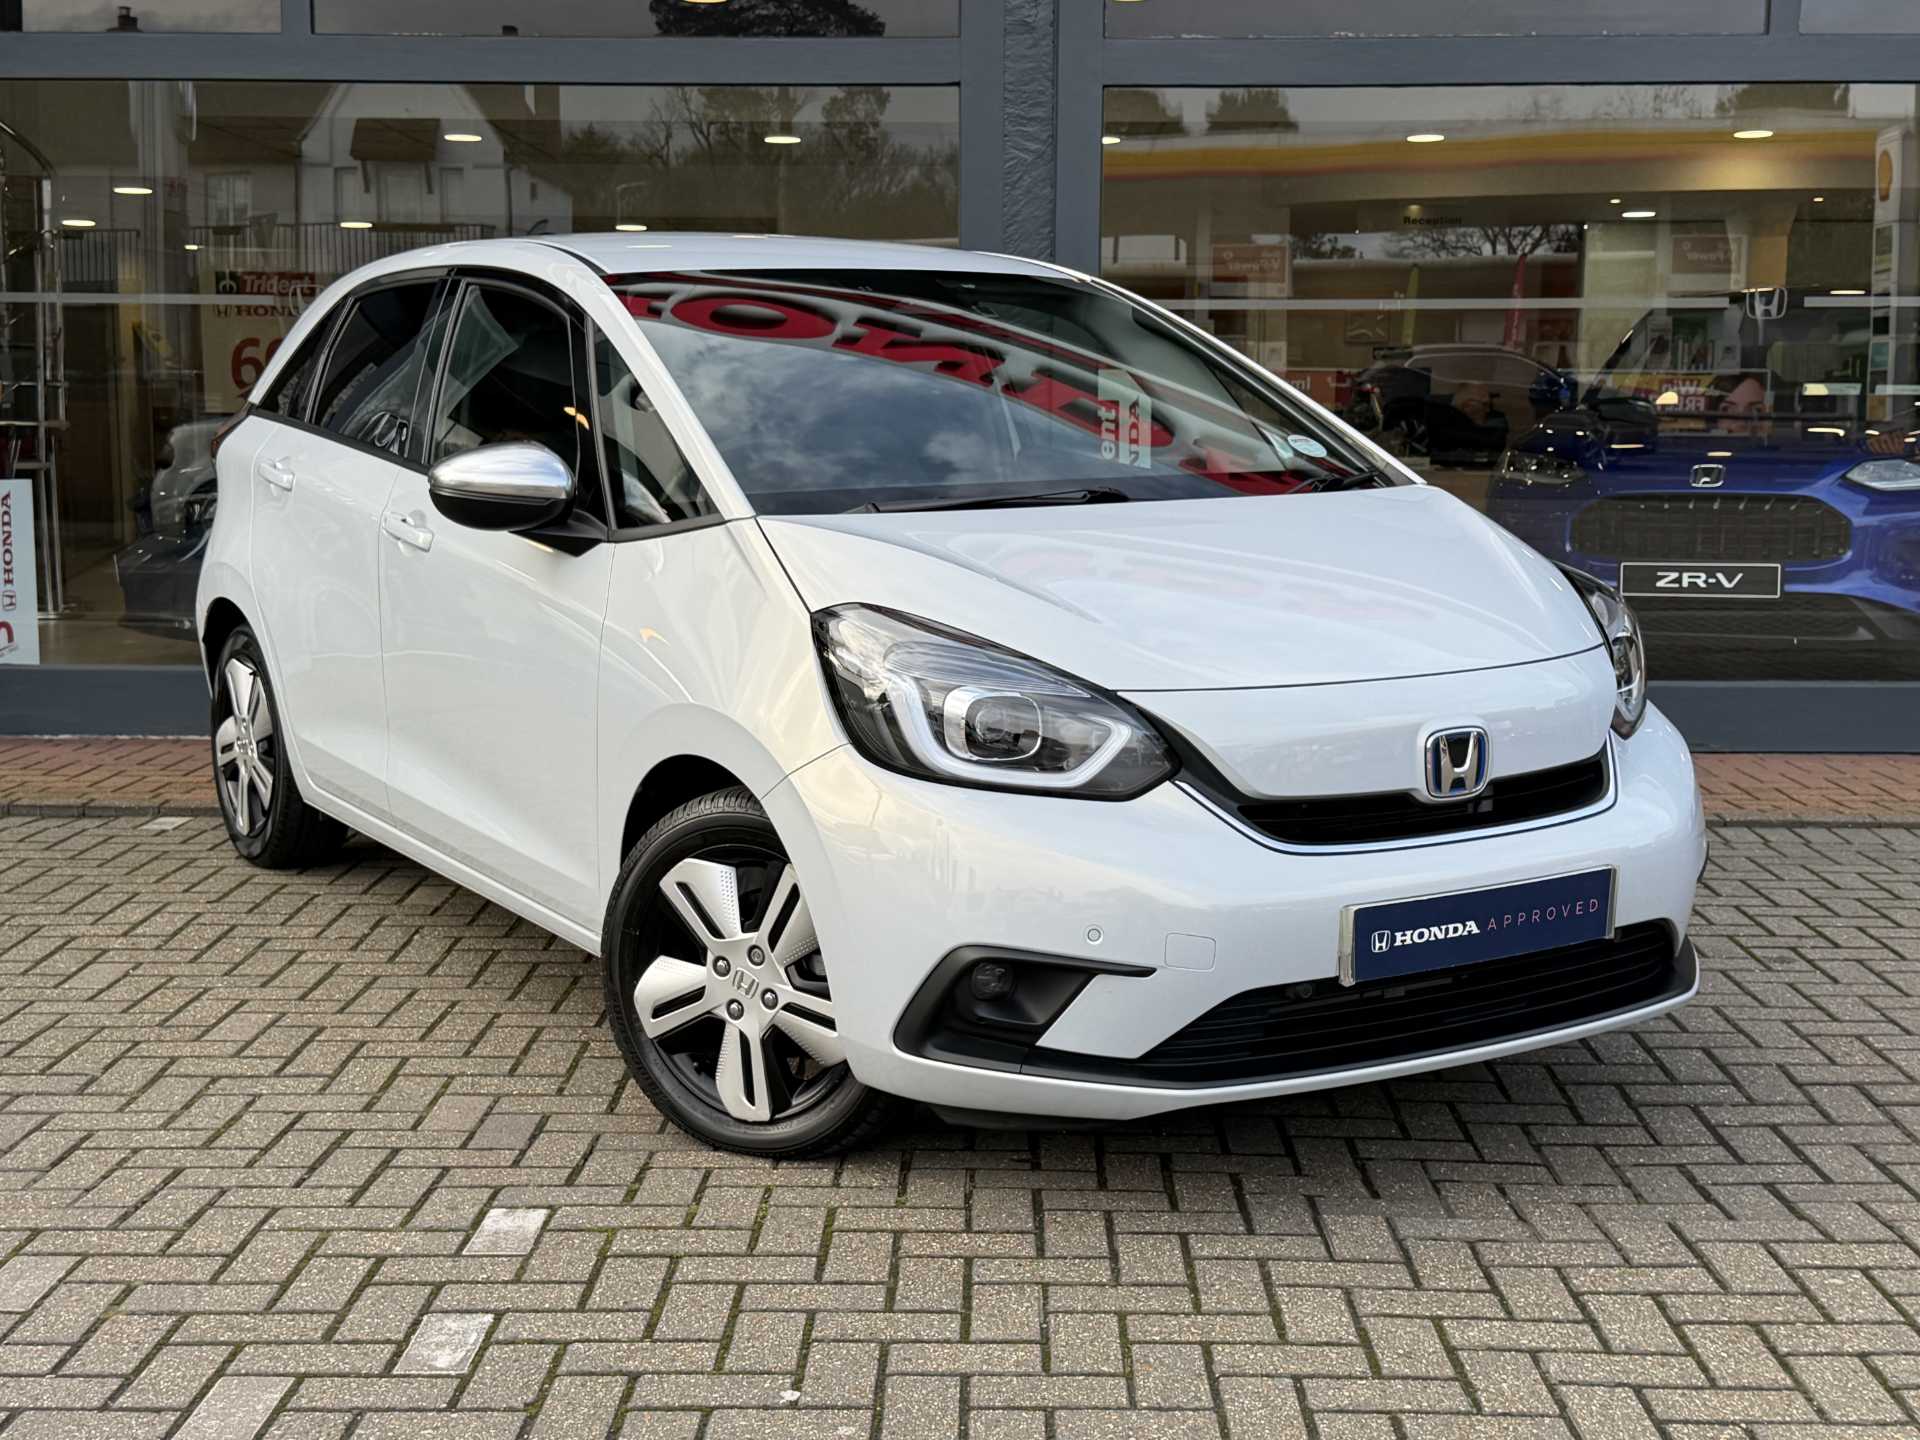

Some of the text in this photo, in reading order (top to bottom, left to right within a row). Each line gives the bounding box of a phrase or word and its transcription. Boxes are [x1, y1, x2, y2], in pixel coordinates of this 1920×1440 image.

[244, 276, 312, 293] Trident
[1, 488, 15, 587] HONDA
[1655, 571, 1744, 589] ZR-V
[1394, 899, 1599, 947] HONDA APPROVED
